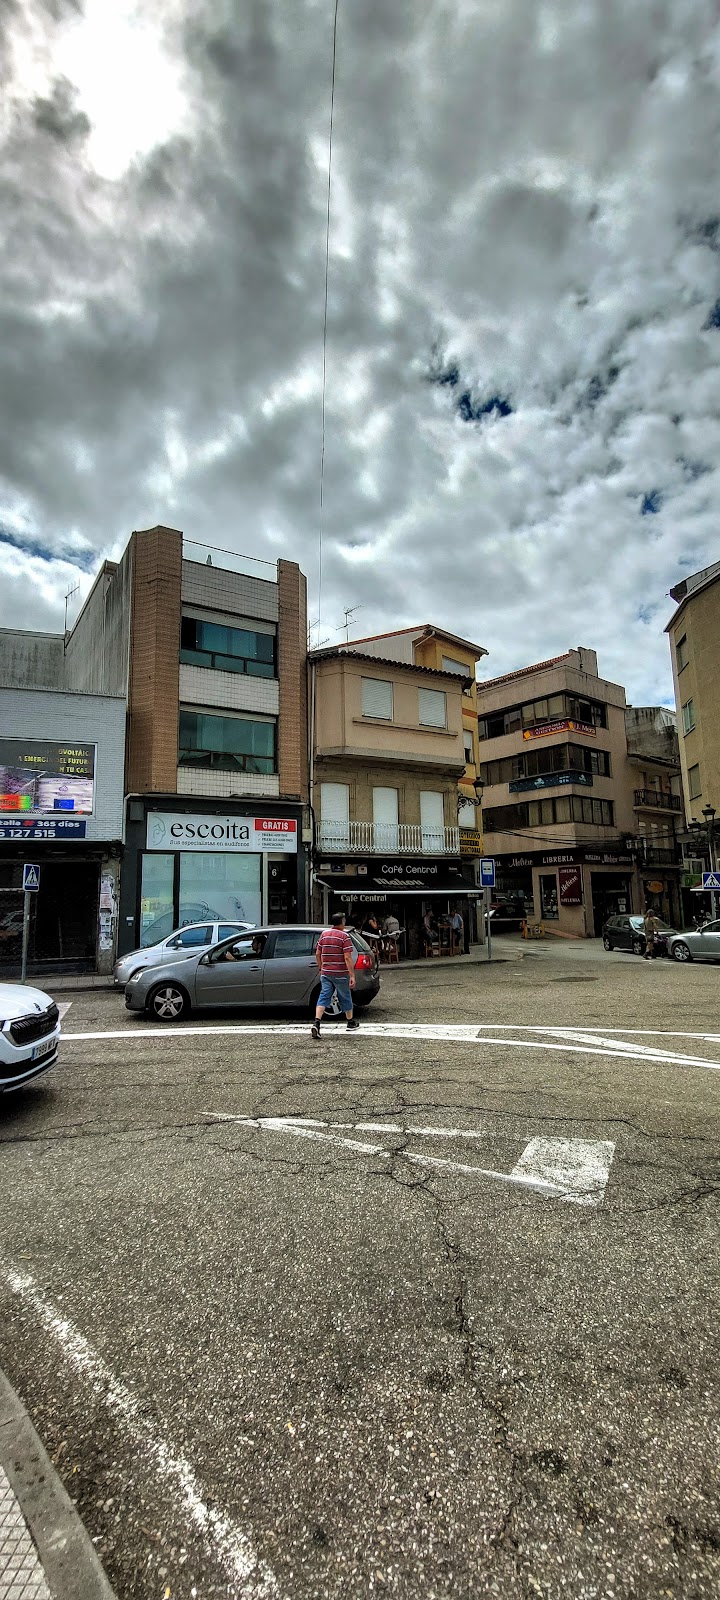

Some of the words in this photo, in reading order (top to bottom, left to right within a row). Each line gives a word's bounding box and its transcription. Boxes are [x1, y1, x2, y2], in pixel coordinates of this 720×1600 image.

[58, 820, 80, 828] días
[262, 821, 289, 830] GRATIS
[9, 829, 32, 838] 127
[34, 829, 56, 838] 515
[170, 819, 250, 840] escoita
[271, 868, 278, 877] 6
[381, 864, 403, 874] Café
[405, 865, 438, 874] Central
[340, 894, 359, 902] Café
[359, 894, 387, 902] Central
